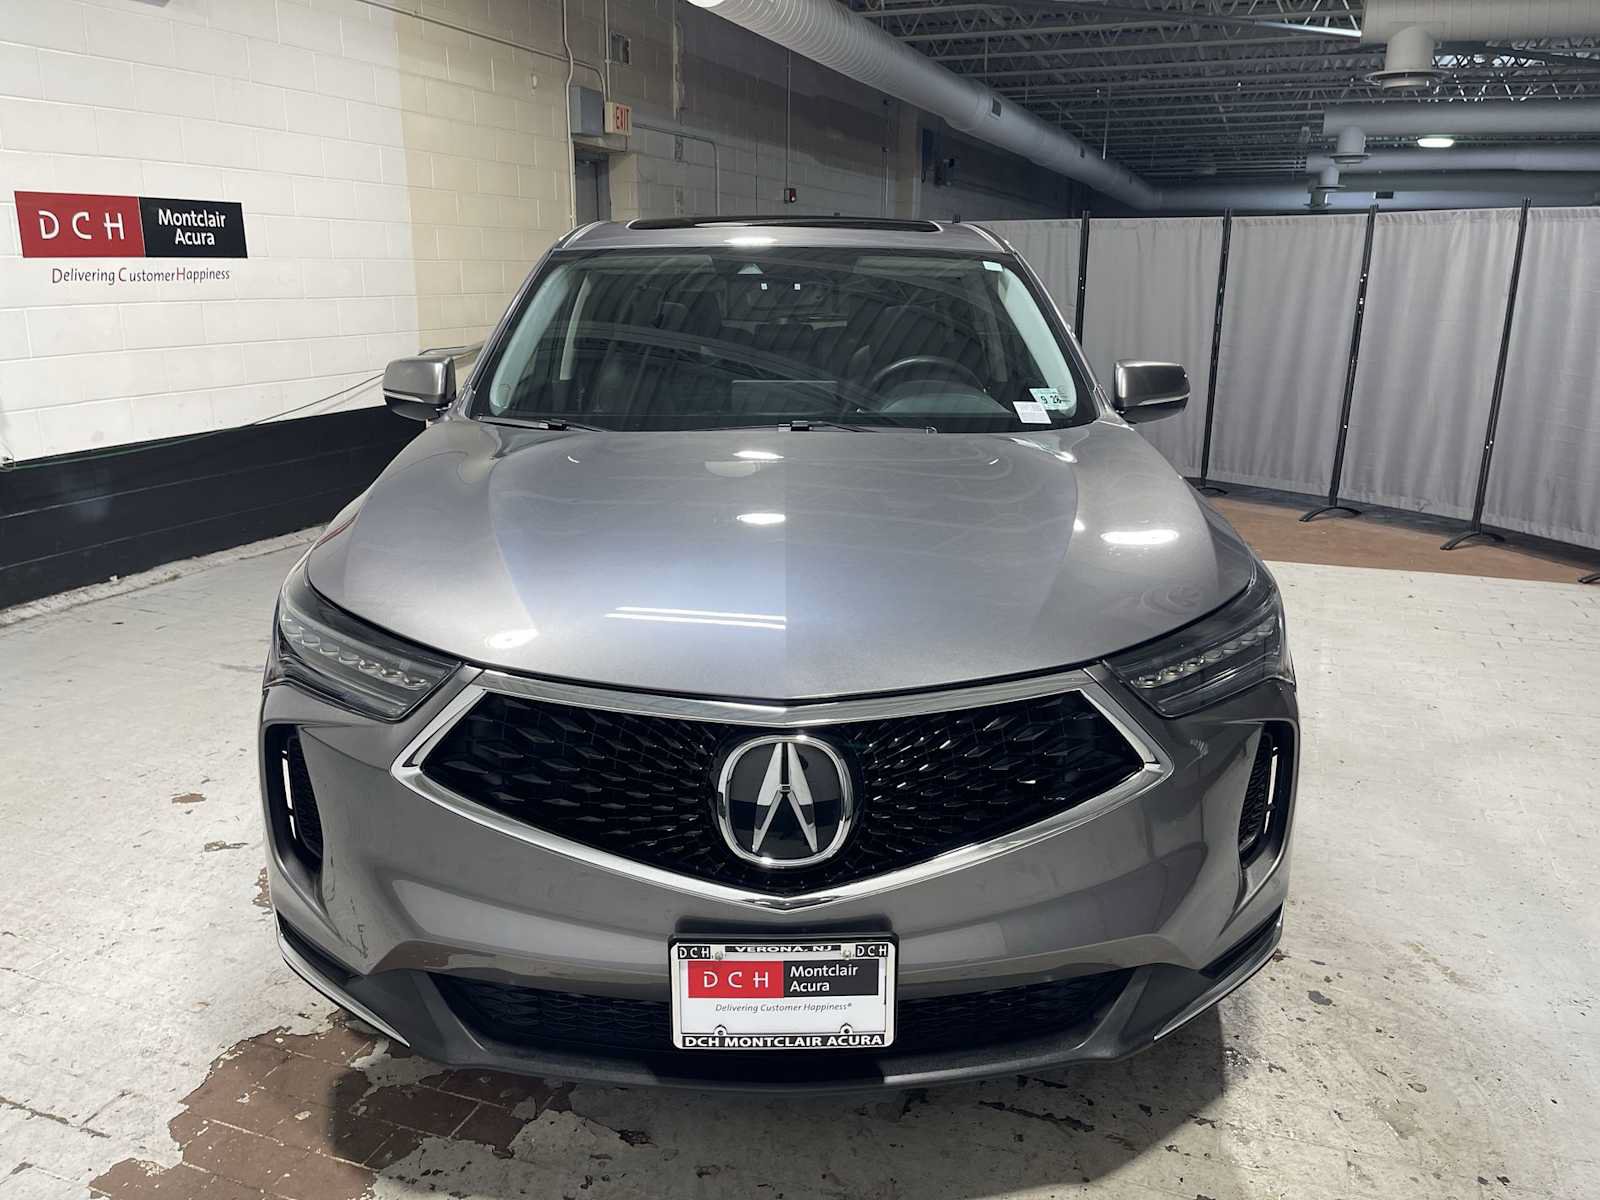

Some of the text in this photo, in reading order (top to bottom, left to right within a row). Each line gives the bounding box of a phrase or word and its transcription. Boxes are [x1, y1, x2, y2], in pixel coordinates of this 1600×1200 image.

[615, 105, 629, 131] EXIT
[158, 208, 226, 229] Montclair
[175, 228, 215, 246] Acura
[52, 267, 115, 286] Delivering
[790, 963, 859, 978] Montclair
[790, 980, 830, 992] Acura
[715, 1003, 759, 1013] Delivering
[760, 1003, 801, 1012] Customer
[684, 1035, 883, 1048] DCH MONTCLAIR ACURA
